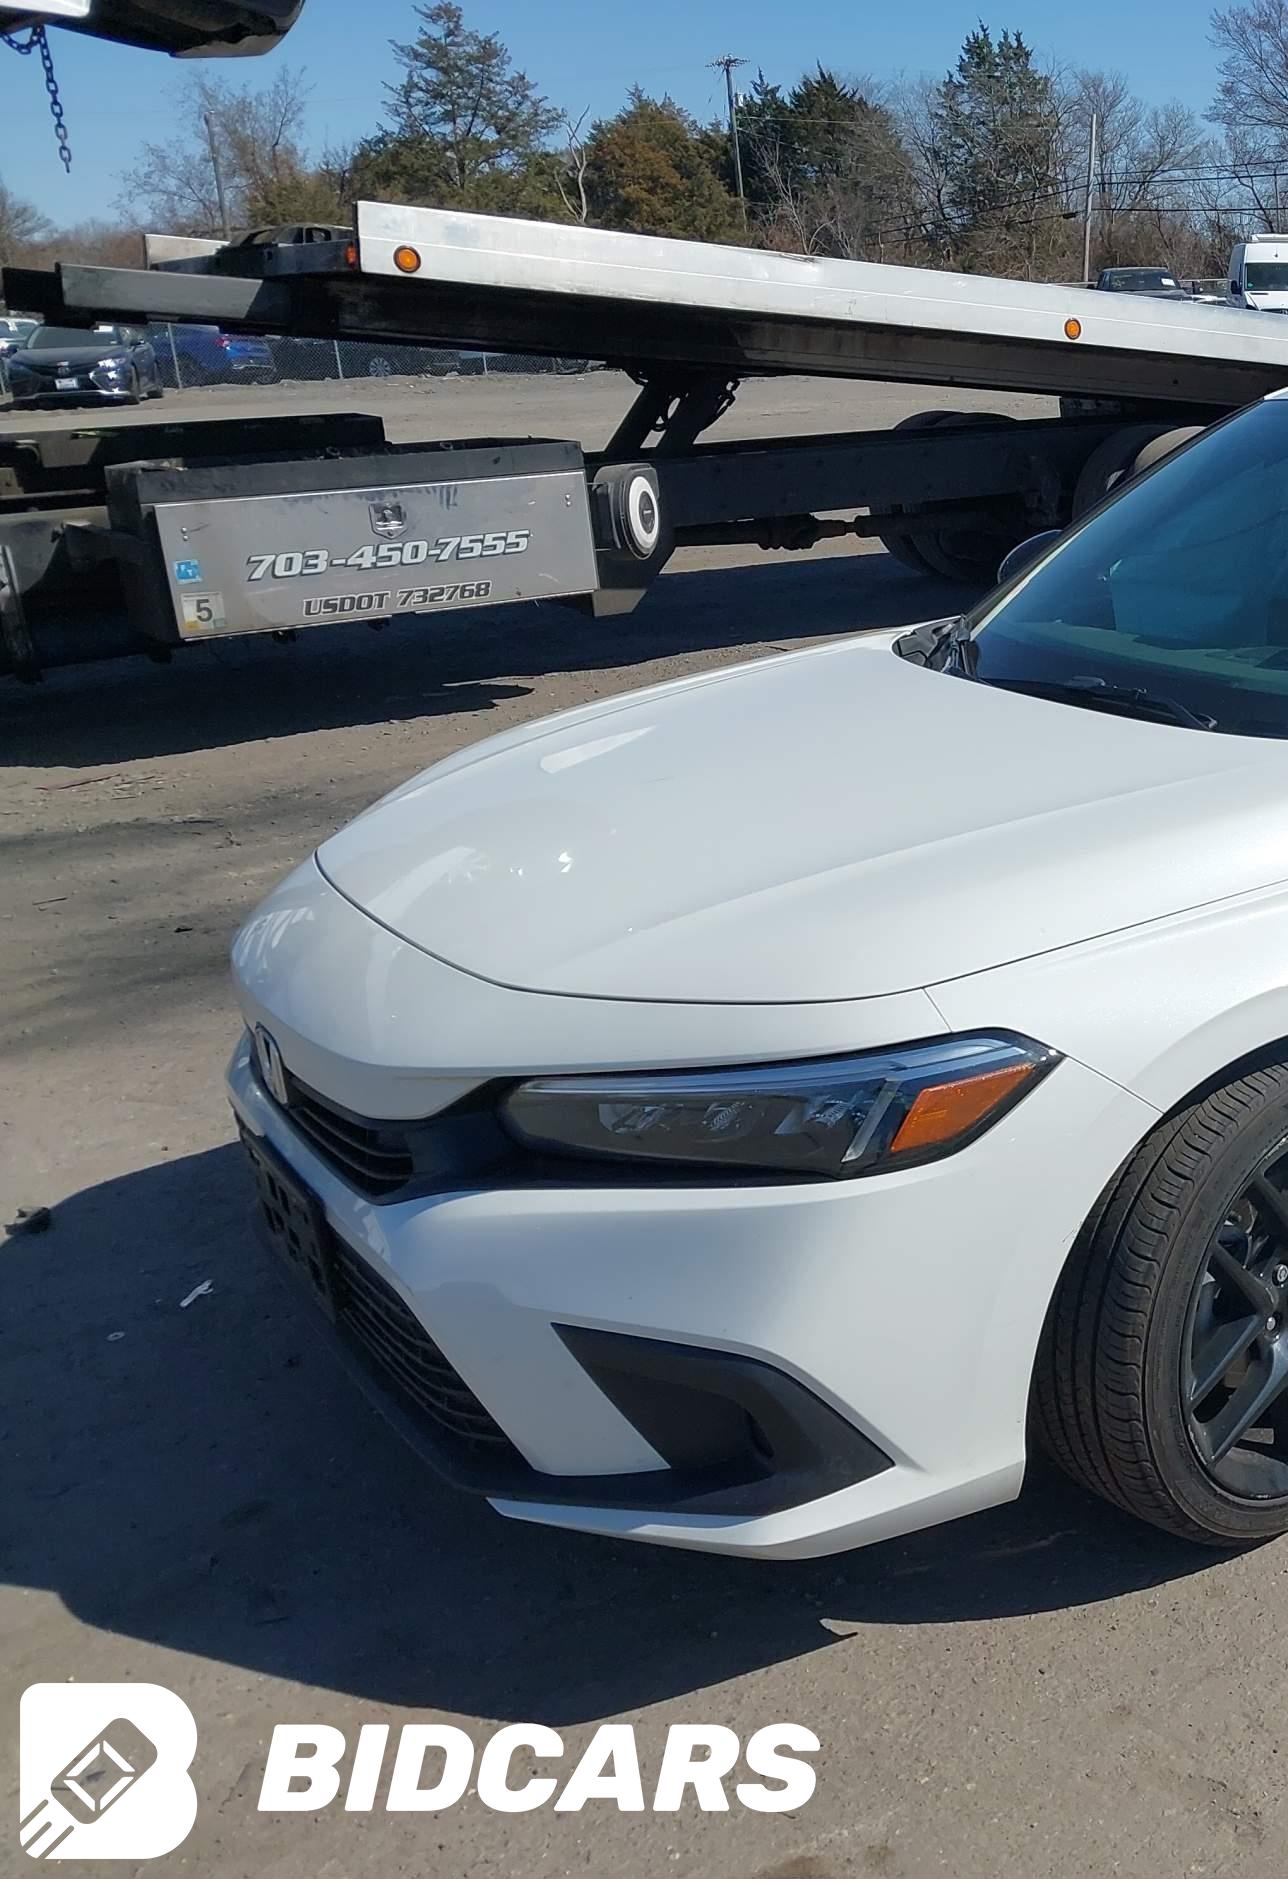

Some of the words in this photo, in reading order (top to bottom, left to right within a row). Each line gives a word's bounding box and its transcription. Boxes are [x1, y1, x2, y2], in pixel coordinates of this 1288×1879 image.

[247, 530, 530, 581] 703-450-7555
[196, 598, 213, 623] 5
[303, 592, 391, 617] USDOT
[398, 580, 491, 608] 732768
